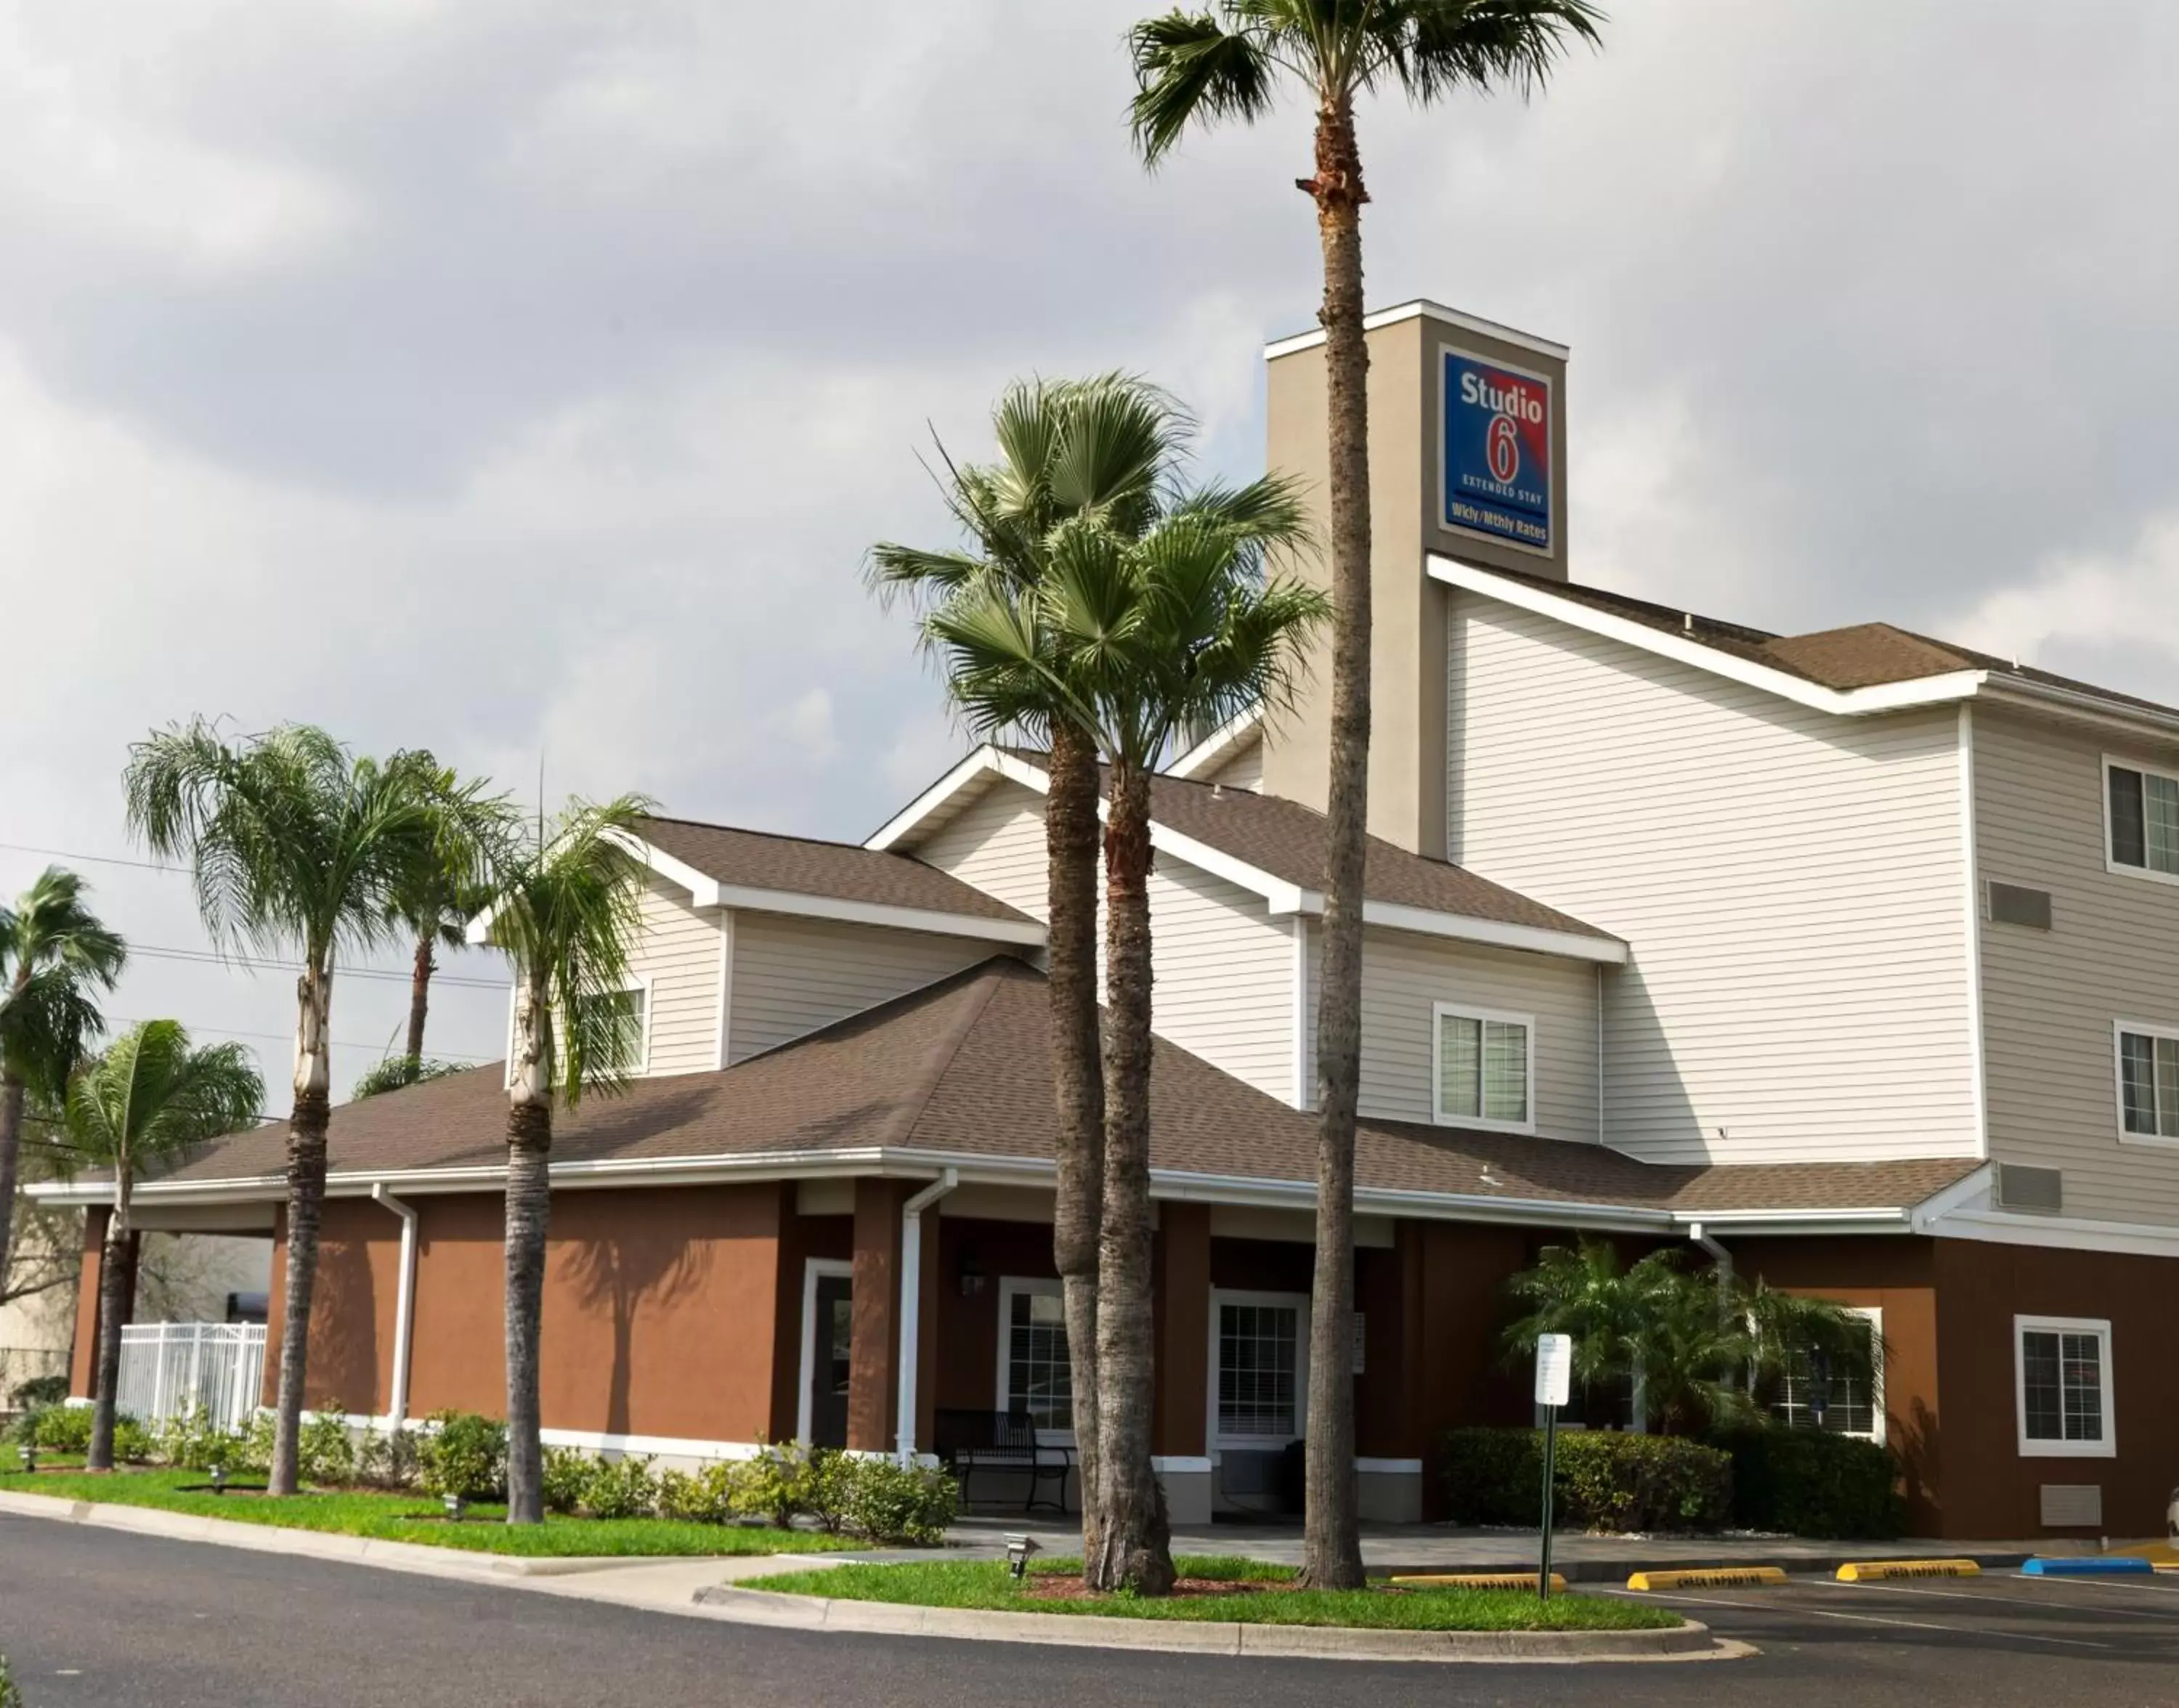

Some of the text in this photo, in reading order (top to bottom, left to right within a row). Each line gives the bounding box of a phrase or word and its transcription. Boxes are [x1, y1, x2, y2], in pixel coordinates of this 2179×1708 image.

[1461, 371, 1542, 424] Studio
[1487, 412, 1519, 484] 6
[1462, 473, 1542, 506] EXTENDED STAY
[1452, 502, 1546, 540] Wkly/Mthly Rates
